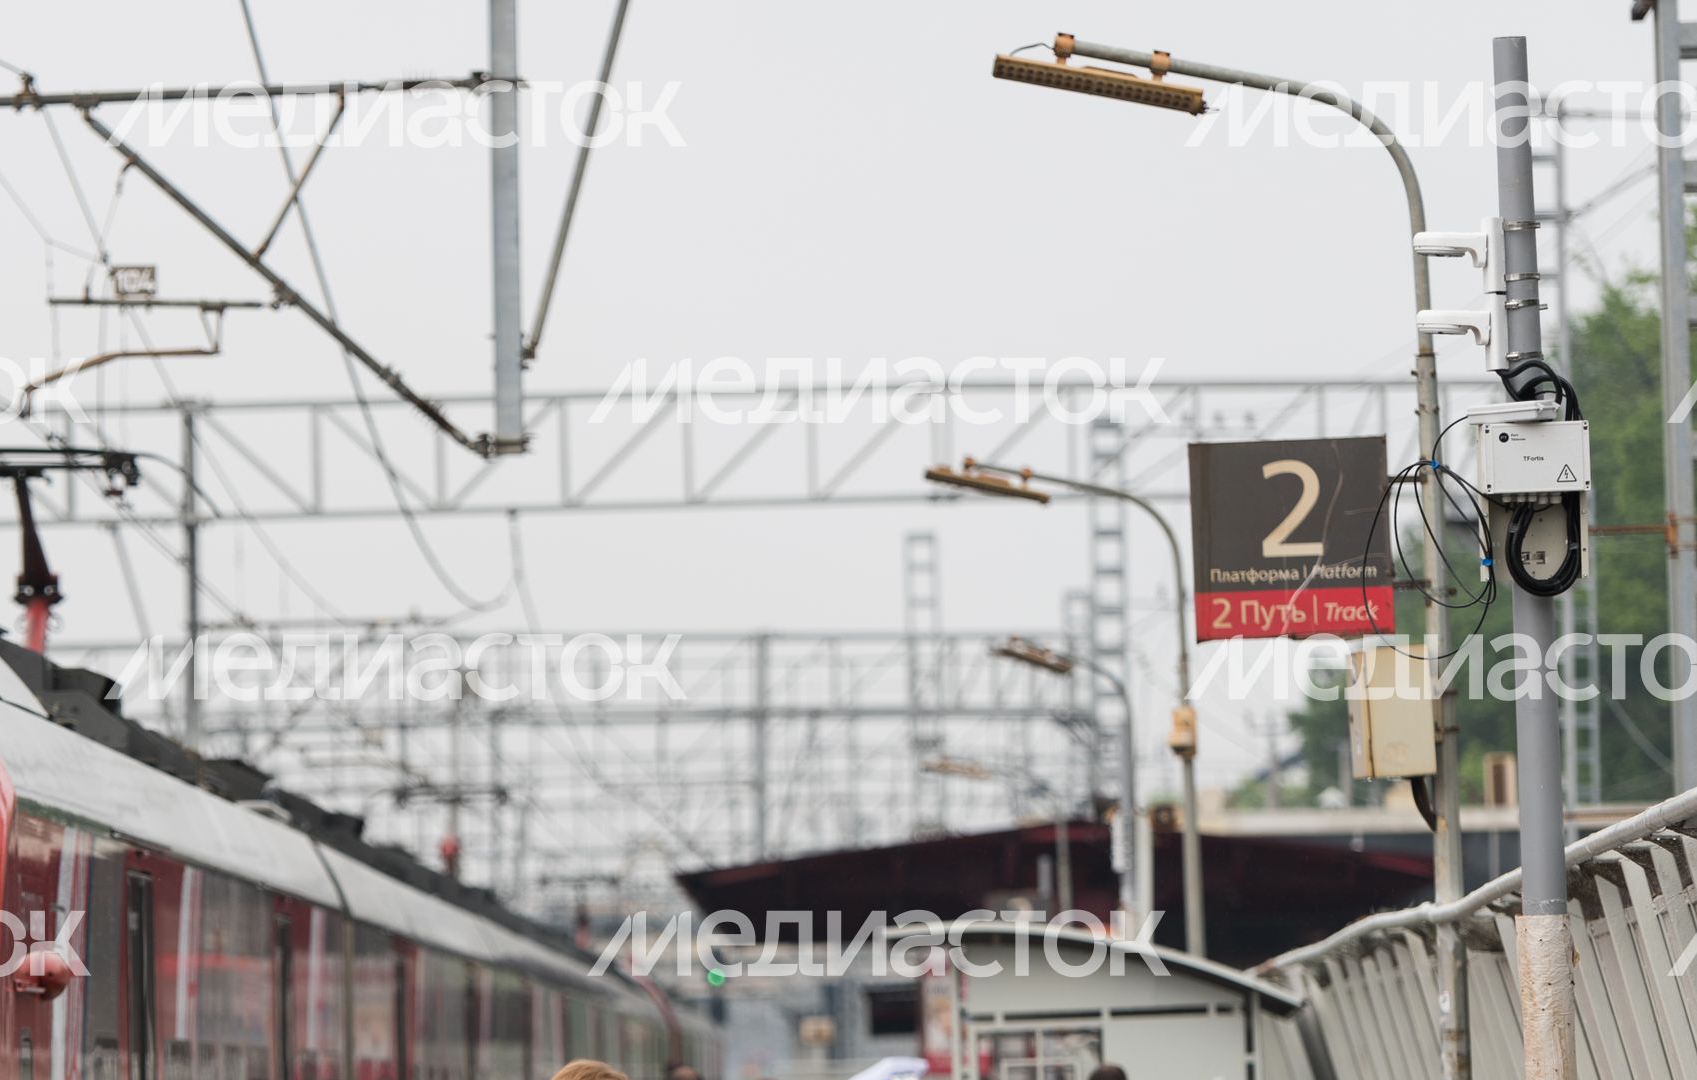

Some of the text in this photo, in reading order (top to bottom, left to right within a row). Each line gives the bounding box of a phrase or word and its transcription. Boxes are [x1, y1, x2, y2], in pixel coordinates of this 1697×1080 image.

[1262, 459, 1324, 558] 2
[1210, 567, 1299, 585] Платформа
[1212, 597, 1380, 632] 2 Путь Track
